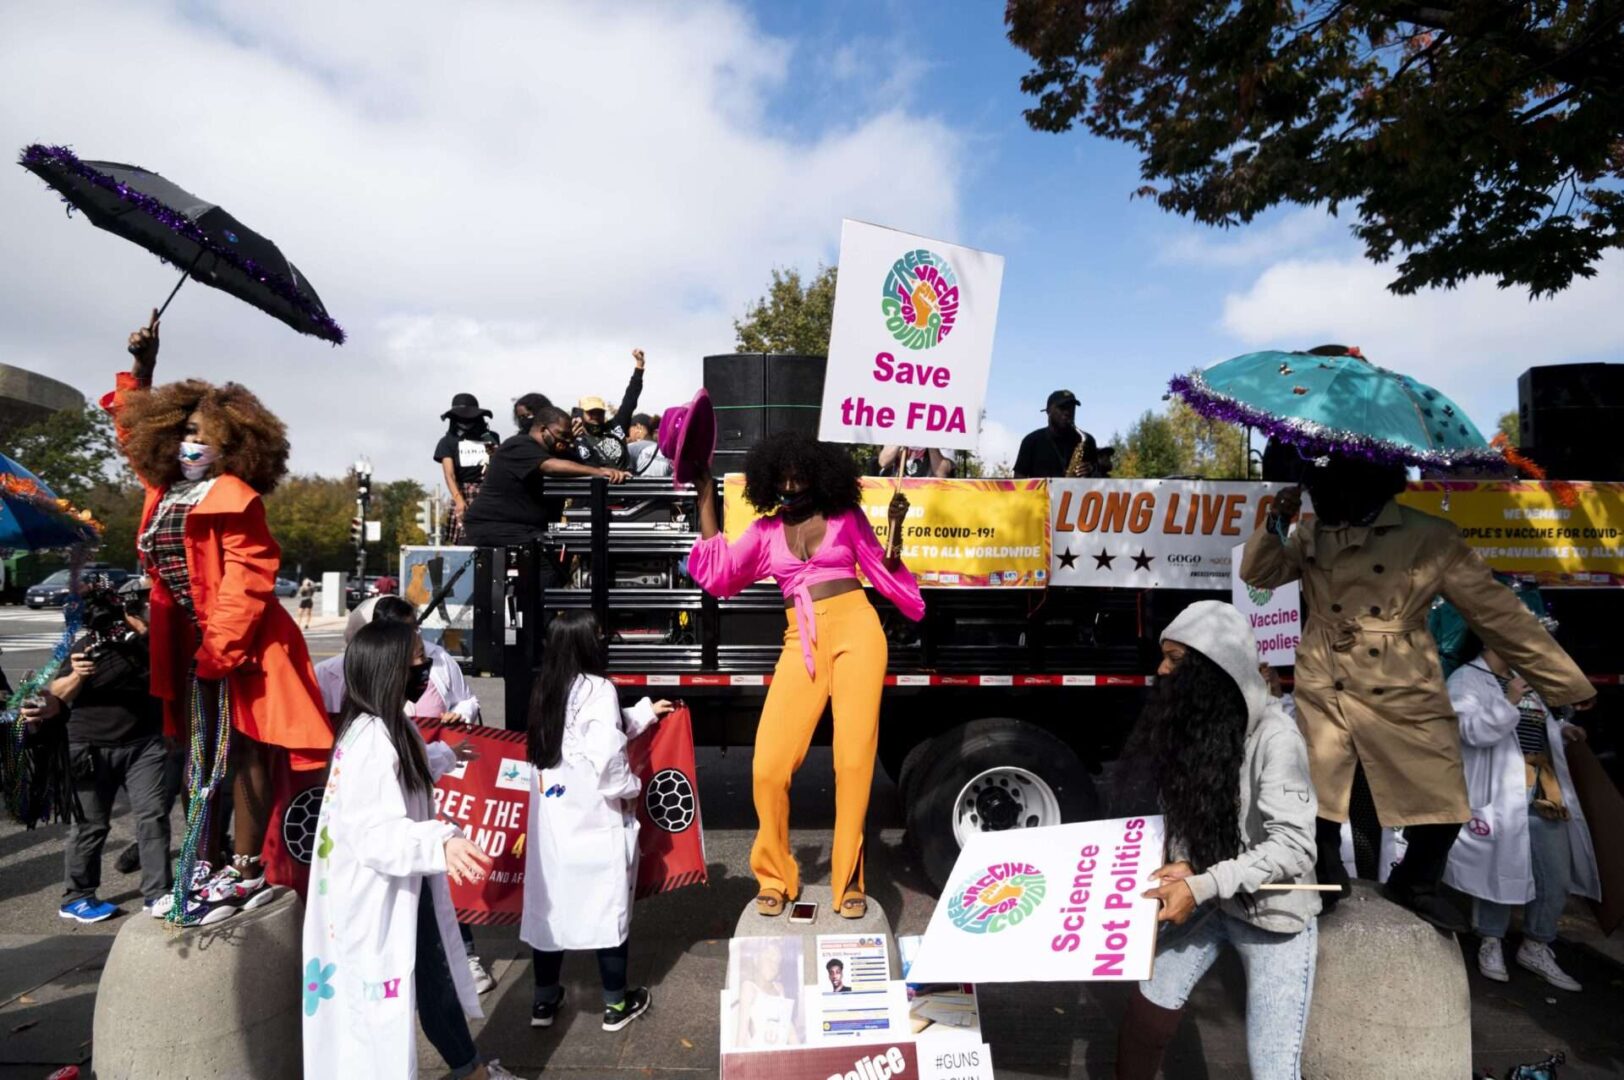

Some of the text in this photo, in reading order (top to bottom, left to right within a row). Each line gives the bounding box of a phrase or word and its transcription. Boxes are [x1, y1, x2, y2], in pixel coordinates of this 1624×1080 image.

[883, 249, 934, 303] FREE
[898, 283, 917, 324] FOR
[914, 265, 959, 343] VACCINE
[873, 352, 951, 388] Save
[841, 397, 966, 434] the FDA
[1055, 491, 1156, 534] LONG
[1162, 493, 1247, 535] LIVE
[1503, 508, 1571, 519] WE DEMAND
[907, 526, 995, 538] FOR COVID-19!
[1462, 527, 1502, 538] OPLE'S
[1505, 527, 1554, 538] VACCINE
[1556, 527, 1580, 538] FOR
[921, 546, 938, 558] TO
[940, 546, 961, 558] ALL
[964, 546, 1041, 558] WORLDWIDE
[1167, 554, 1202, 564] GOGO
[1591, 547, 1615, 558] ALL
[1249, 608, 1299, 628] Vaccine
[432, 787, 525, 829] REE THE
[489, 870, 510, 883] AND
[963, 862, 1042, 908] VACCINE
[948, 891, 994, 934] FREE
[976, 897, 1018, 920] FOR
[1051, 844, 1100, 952] Science
[1092, 818, 1146, 976] Not Politics
[935, 1050, 980, 1070] #GUNS
